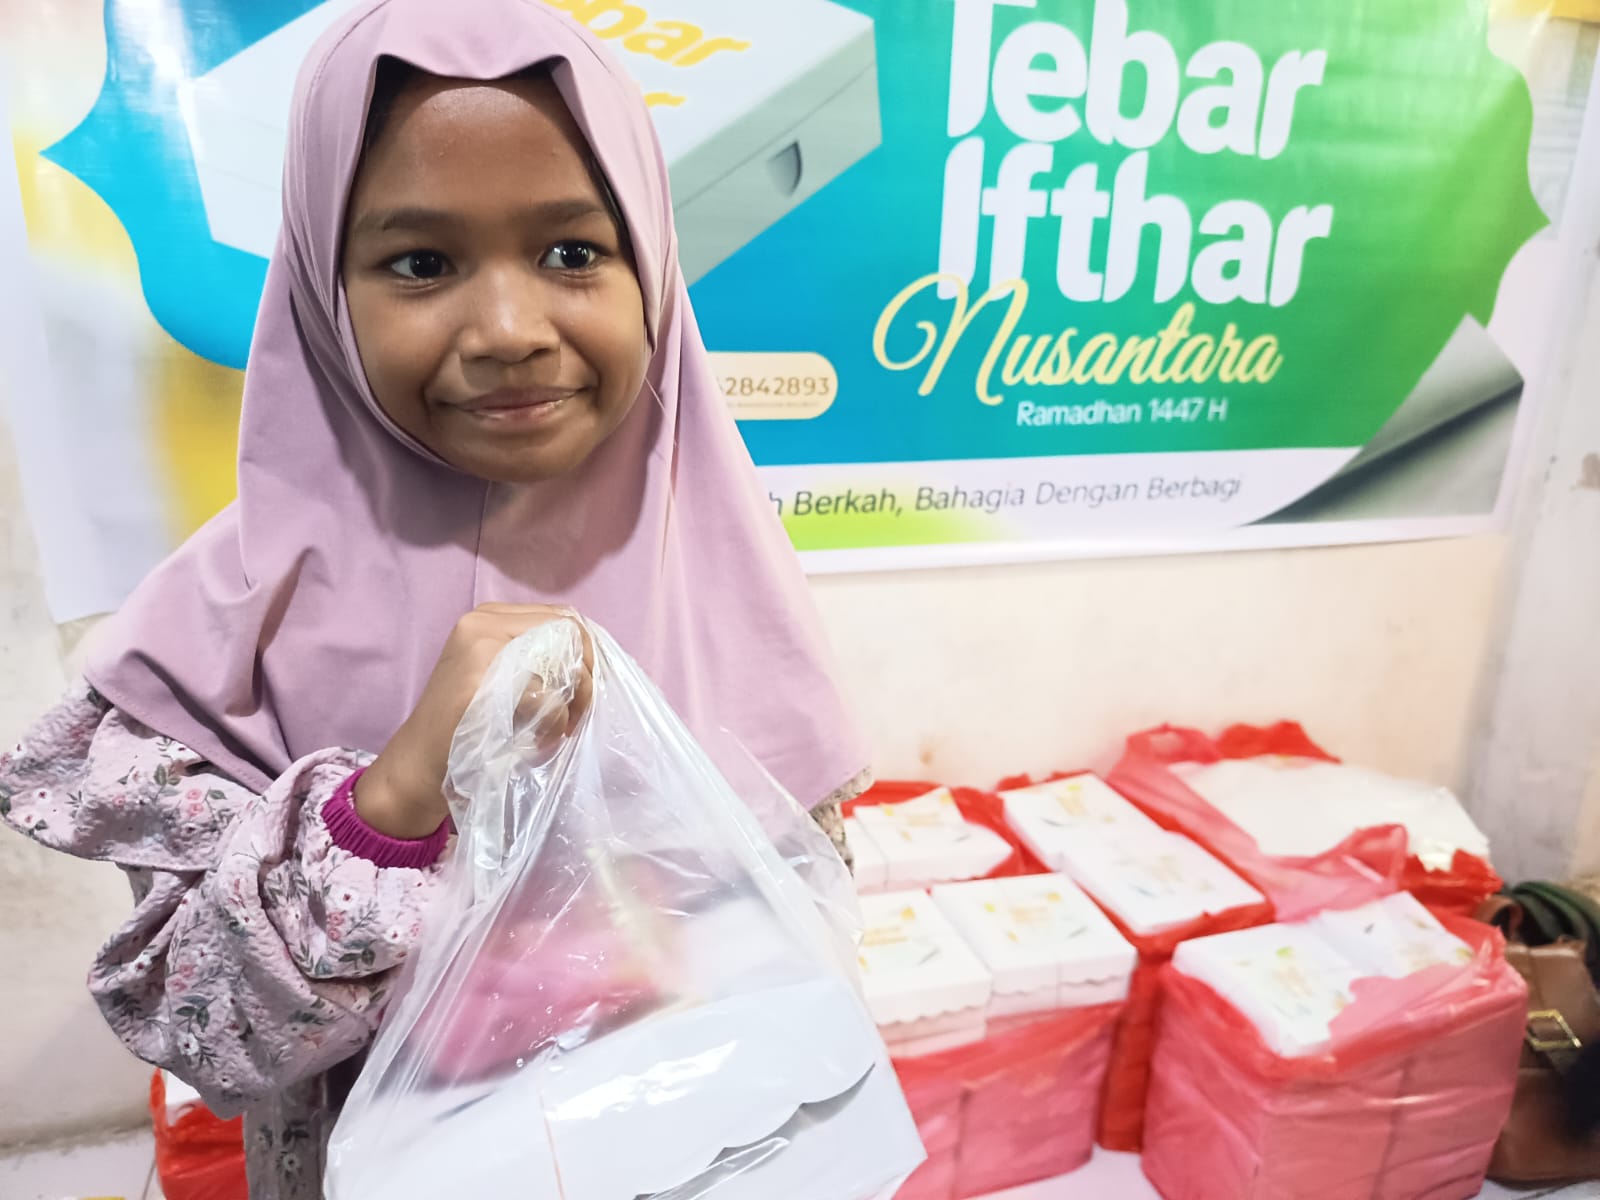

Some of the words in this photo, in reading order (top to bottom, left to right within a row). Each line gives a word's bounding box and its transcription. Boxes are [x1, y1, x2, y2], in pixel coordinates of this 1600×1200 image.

[543, 0, 752, 67] bar
[946, 0, 1328, 160] Tebar
[937, 136, 1334, 307] Ifthar
[872, 272, 1283, 405] Nusantara
[716, 376, 830, 396] 2842893
[1016, 400, 1142, 427] Ramadhan
[1148, 397, 1205, 423] 1447
[1206, 397, 1229, 422] H
[793, 488, 903, 517] Berkah,
[915, 483, 1025, 514] Bahagia
[1035, 481, 1139, 509] Dengan
[1146, 475, 1242, 503] Berbagi
